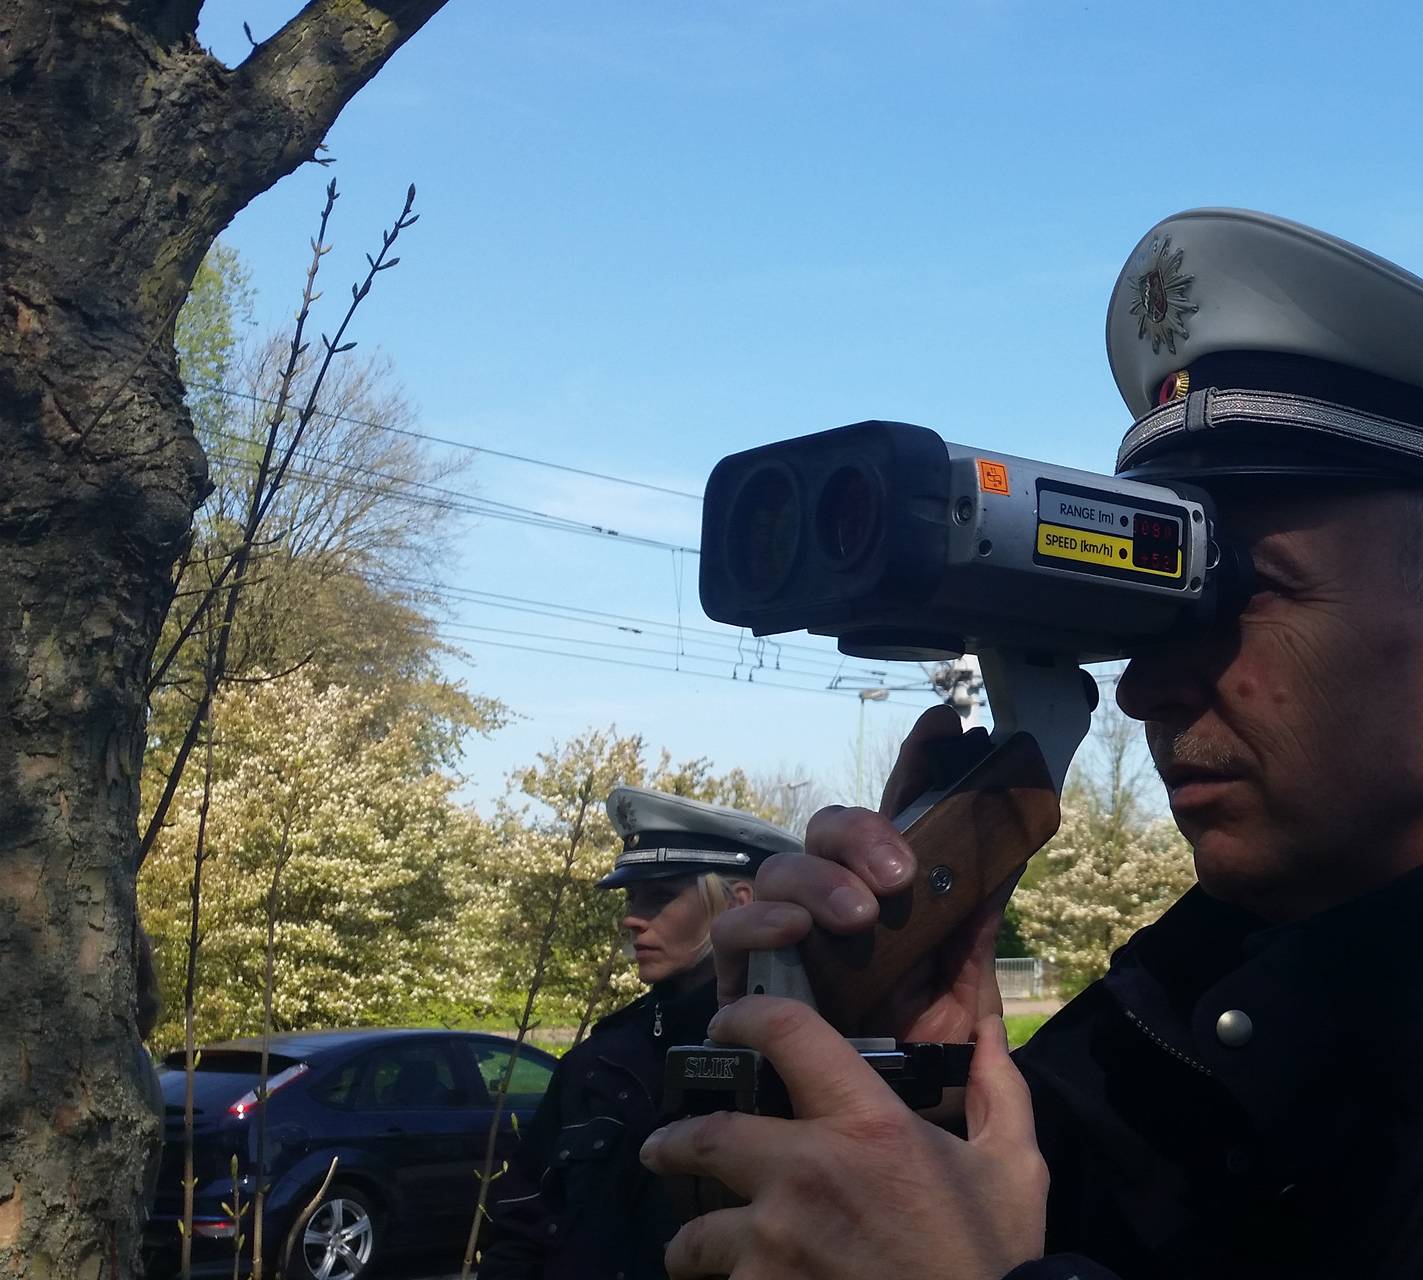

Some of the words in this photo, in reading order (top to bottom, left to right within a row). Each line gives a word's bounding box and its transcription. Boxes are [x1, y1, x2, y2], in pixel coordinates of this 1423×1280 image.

[1060, 502, 1095, 521] RANGE
[1045, 533, 1078, 550] SPEED
[1080, 539, 1113, 558] [km/h]
[684, 1056, 736, 1078] SLIK
